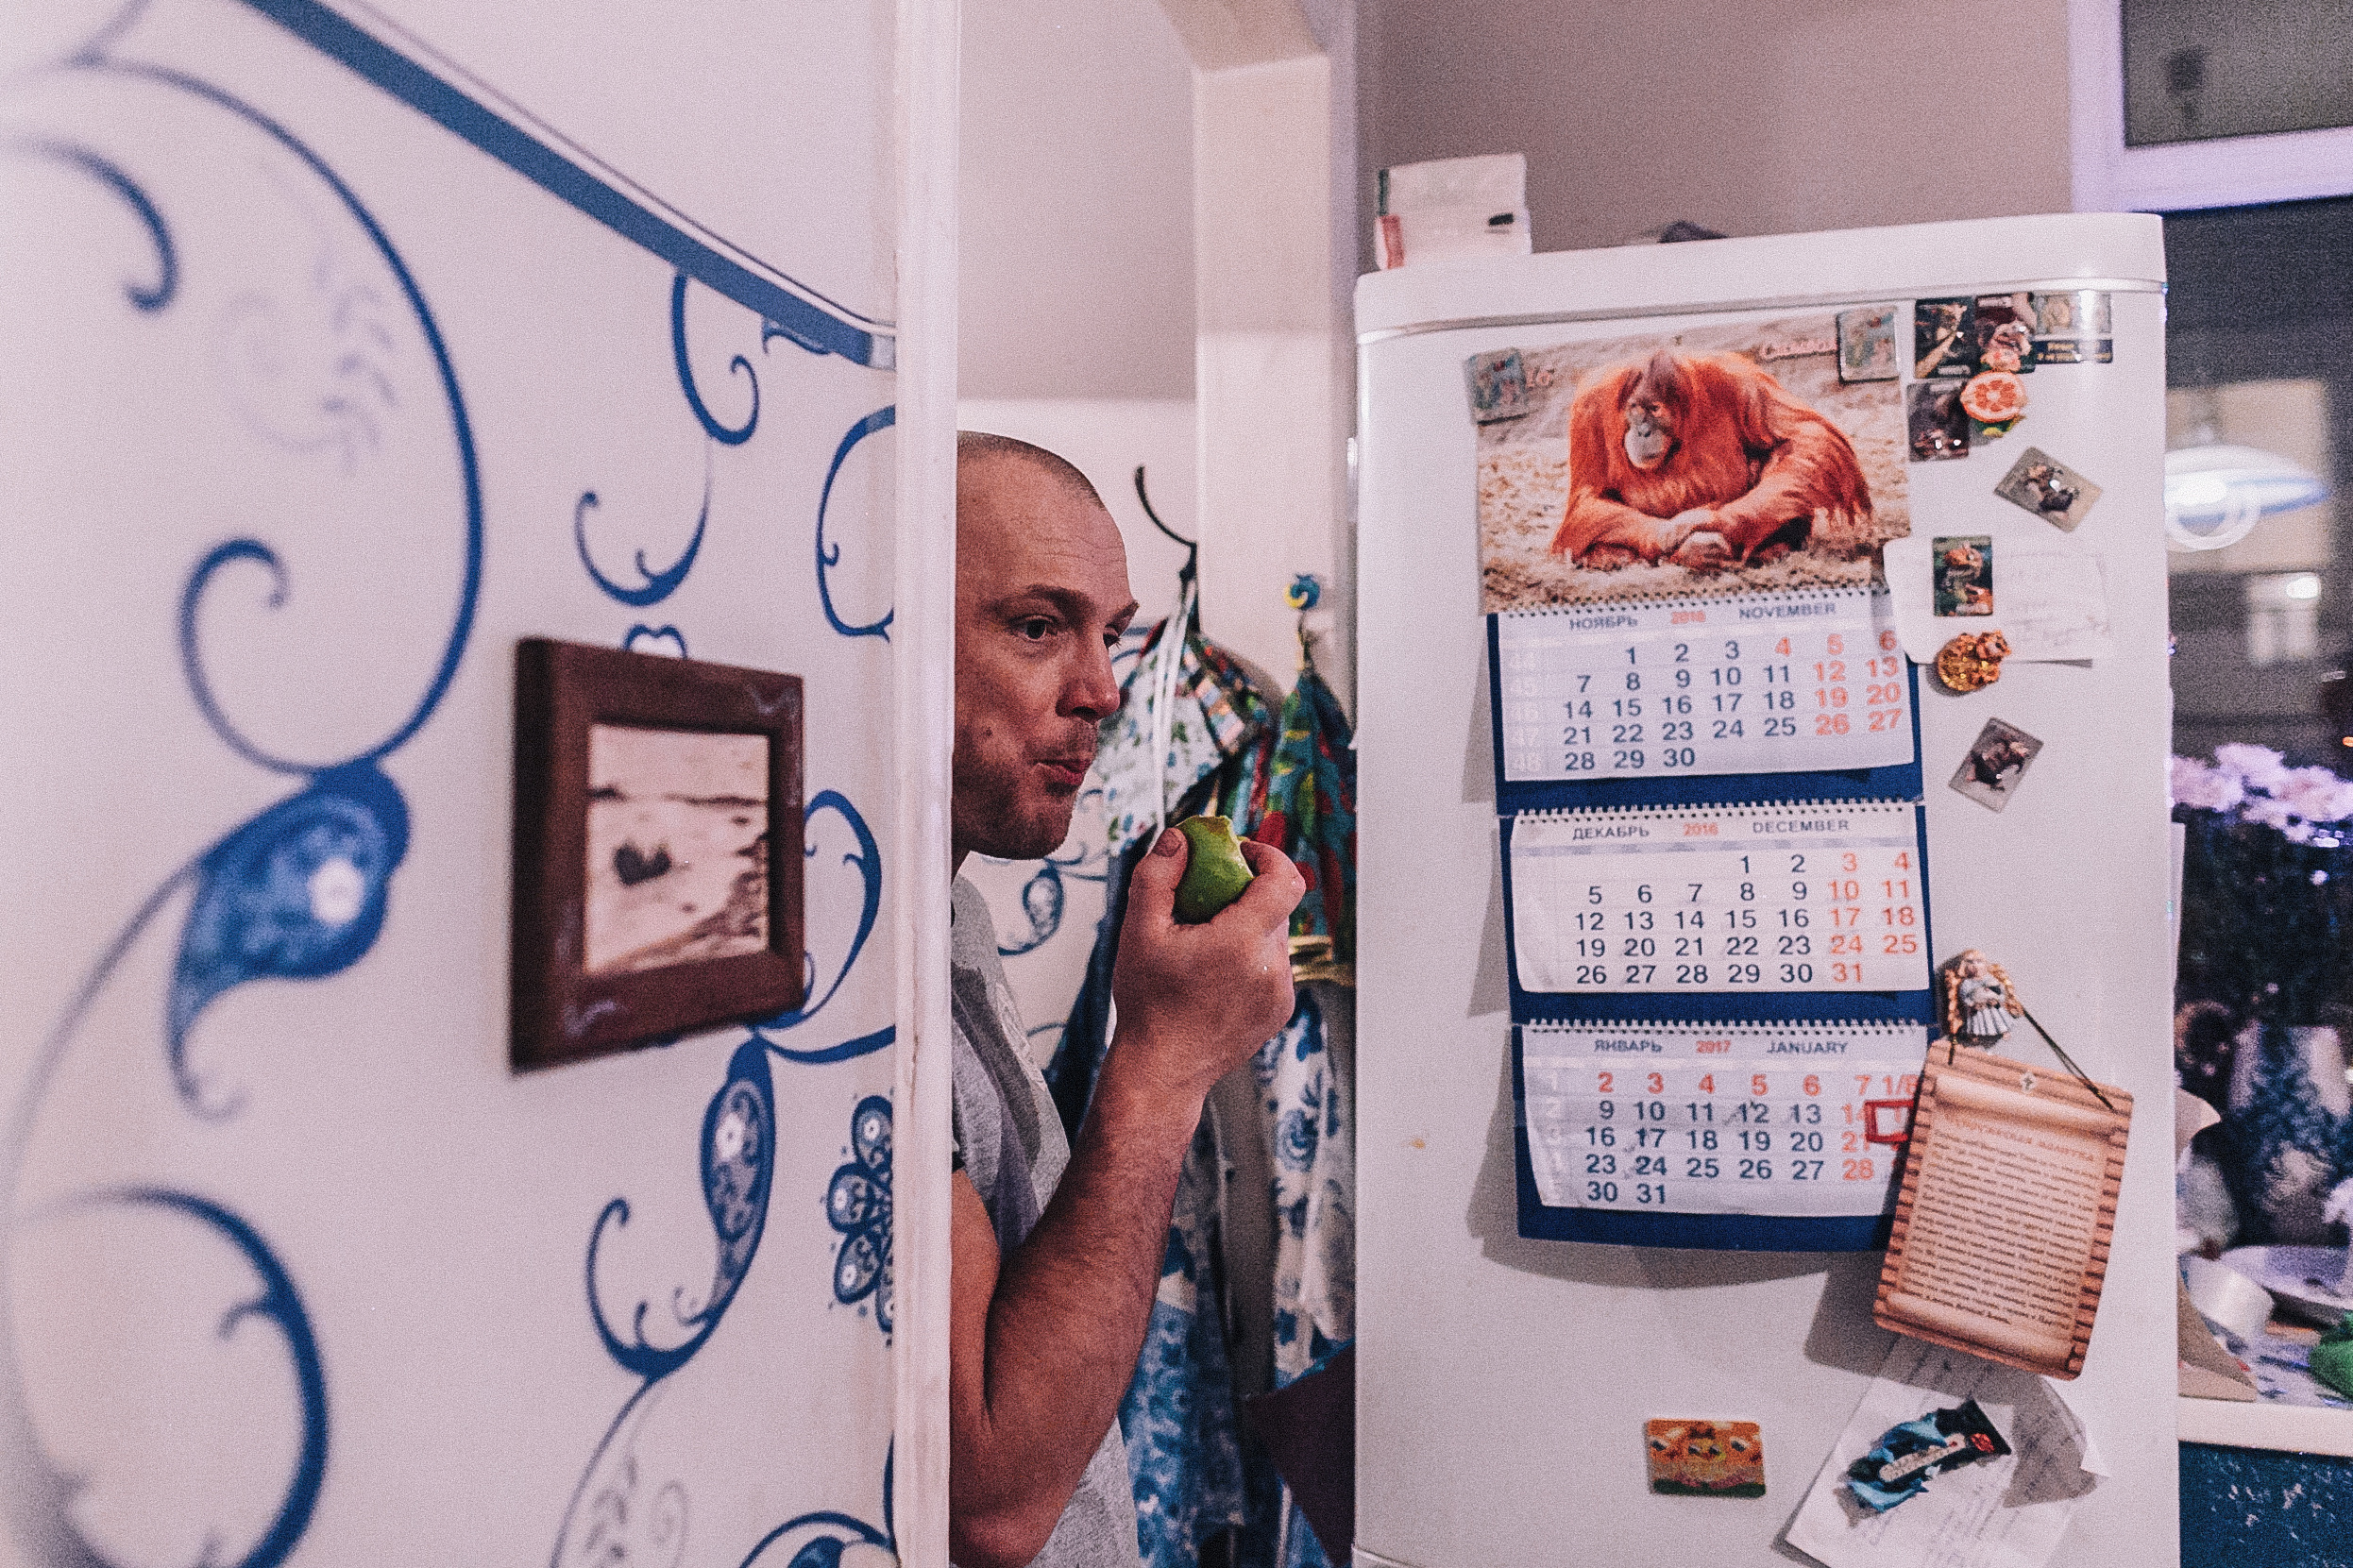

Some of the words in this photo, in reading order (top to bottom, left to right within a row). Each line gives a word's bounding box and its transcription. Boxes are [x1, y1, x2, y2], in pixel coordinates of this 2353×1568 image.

[1569, 615, 1638, 631] НОЯБРЬ
[1739, 602, 1836, 619] NOVEMBER
[1626, 647, 1635, 664] 1
[1675, 644, 1688, 662] 2
[1725, 640, 1739, 660] 3
[1775, 636, 1791, 656] 4
[1827, 633, 1843, 655] 5
[1879, 630, 1896, 650] 6
[1577, 675, 1590, 693] 7
[1626, 672, 1640, 690] 8
[1676, 669, 1690, 688] 9
[1711, 666, 1741, 685] 10
[1763, 665, 1788, 683] 11
[1814, 661, 1845, 682] 12
[1866, 656, 1898, 678] 13
[1564, 700, 1592, 719] 14
[1614, 699, 1641, 717] 15
[1663, 696, 1691, 715] 16
[1713, 693, 1743, 712] 17
[1764, 691, 1794, 709] 18
[1816, 687, 1848, 708] 19
[1867, 683, 1901, 705] 20
[1564, 727, 1590, 744] 21
[1613, 724, 1644, 742] 22
[1663, 721, 1693, 740] 23
[1713, 719, 1744, 738] 24
[1765, 717, 1796, 736] 25
[1816, 714, 1850, 735] 26
[1869, 709, 1903, 732] 27
[1566, 752, 1595, 770] 28
[1615, 750, 1644, 768] 29
[1664, 748, 1695, 767] 30
[1572, 825, 1650, 840] ДЕКАБРЬ
[1684, 823, 1718, 836] 2016
[1752, 819, 1850, 834] DECEMBER
[1740, 855, 1751, 873] 1
[1791, 854, 1805, 873] 2
[1842, 853, 1857, 871] 3
[1894, 851, 1909, 870] 4
[1589, 885, 1601, 904] 5
[1637, 885, 1652, 903] 6
[1687, 885, 1702, 902] 7
[1740, 883, 1754, 902] 8
[1793, 882, 1807, 901] 9
[1829, 881, 1860, 901] 10
[1883, 880, 1909, 899] 11
[1574, 912, 1604, 931] 12
[1624, 911, 1653, 930] 13
[1674, 911, 1705, 930] 14
[1725, 909, 1757, 929] 15
[1778, 908, 1809, 928] 16
[1831, 907, 1860, 927] 17
[1883, 905, 1915, 926] 18
[1577, 938, 1605, 958] 19
[1624, 938, 1656, 957] 20
[1675, 937, 1703, 956] 21
[1727, 936, 1759, 955] 22
[1778, 936, 1811, 955] 23
[1831, 935, 1863, 954] 24
[1883, 934, 1918, 954] 25
[1576, 966, 1607, 985] 26
[1625, 965, 1656, 984] 27
[1676, 964, 1708, 984] 28
[1728, 963, 1760, 984] 29
[1780, 963, 1813, 983] 30
[1832, 962, 1862, 983] 31
[1594, 1039, 1662, 1053] ЯНВАРЬ
[1696, 1039, 1732, 1054] 2017
[1767, 1040, 1847, 1054] JANUARY
[1598, 1071, 1614, 1093] 2
[1648, 1072, 1664, 1094] 3
[1699, 1073, 1715, 1094] 4
[1752, 1074, 1768, 1096] 5
[1803, 1074, 1820, 1096] 6
[1854, 1075, 1871, 1096] 7
[1600, 1101, 1614, 1120] 9
[1634, 1102, 1666, 1121] 10
[1686, 1103, 1713, 1121] 11
[1740, 1104, 1769, 1124] 12
[1791, 1104, 1820, 1124] 13
[1586, 1126, 1615, 1146] 16
[1636, 1127, 1666, 1147] 17
[1686, 1130, 1718, 1150] 18
[1739, 1133, 1770, 1152] 19
[1791, 1133, 1822, 1152] 20
[1585, 1154, 1616, 1174] 23
[1635, 1155, 1667, 1175] 24
[1686, 1157, 1718, 1178] 25
[1739, 1160, 1772, 1180] 26
[1792, 1160, 1824, 1180] 27
[1843, 1158, 1874, 1180] 28
[1588, 1181, 1617, 1203] 30
[1637, 1183, 1665, 1204] 31
